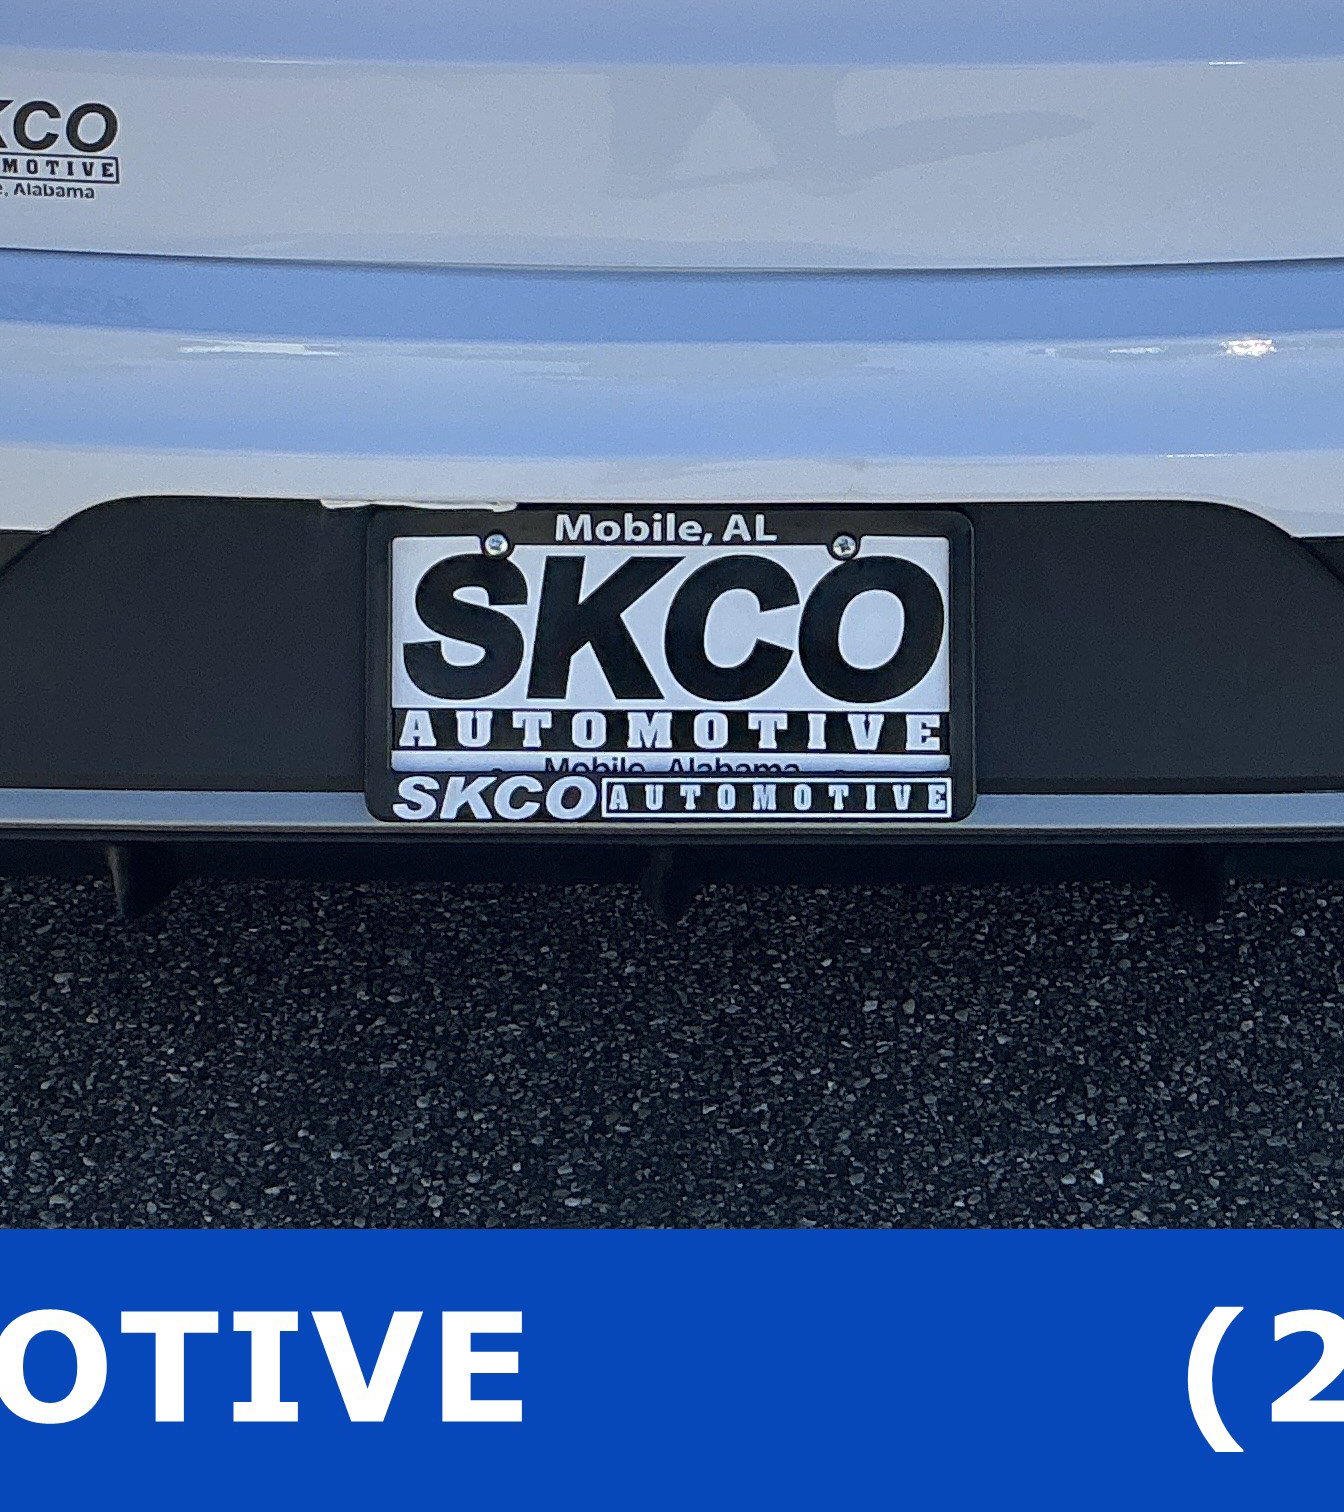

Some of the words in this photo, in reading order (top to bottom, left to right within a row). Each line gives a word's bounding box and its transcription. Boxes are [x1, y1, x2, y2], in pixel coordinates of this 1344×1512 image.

[14, 182, 95, 199] Alabama
[555, 514, 711, 545] Mobile,
[722, 514, 778, 542] AL
[403, 553, 945, 703] SKCO
[399, 710, 942, 751] AUTOMOTIVE
[392, 775, 597, 821] SKCO
[609, 782, 947, 812] AUTOMOTIVE
